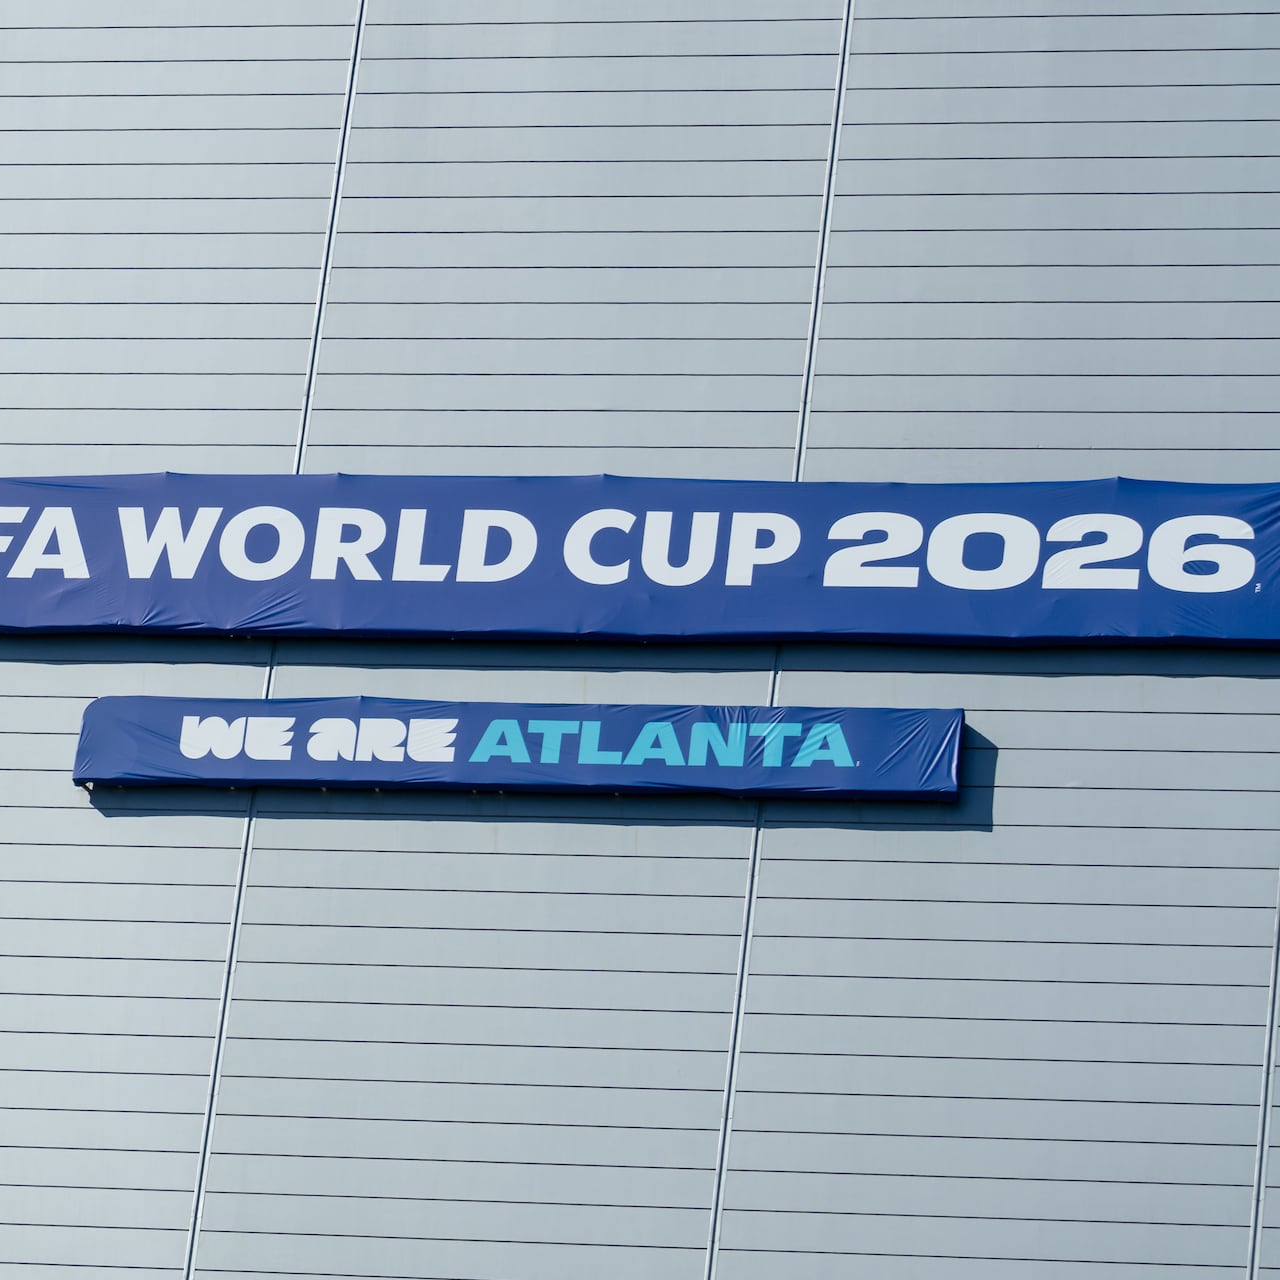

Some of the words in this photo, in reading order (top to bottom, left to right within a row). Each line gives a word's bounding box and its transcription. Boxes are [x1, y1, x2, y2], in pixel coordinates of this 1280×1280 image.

[118, 506, 538, 582] WORLD
[563, 508, 801, 586] CUP
[823, 511, 1256, 593] 2026
[179, 715, 296, 761] WE
[469, 719, 855, 768] ATLANTA
